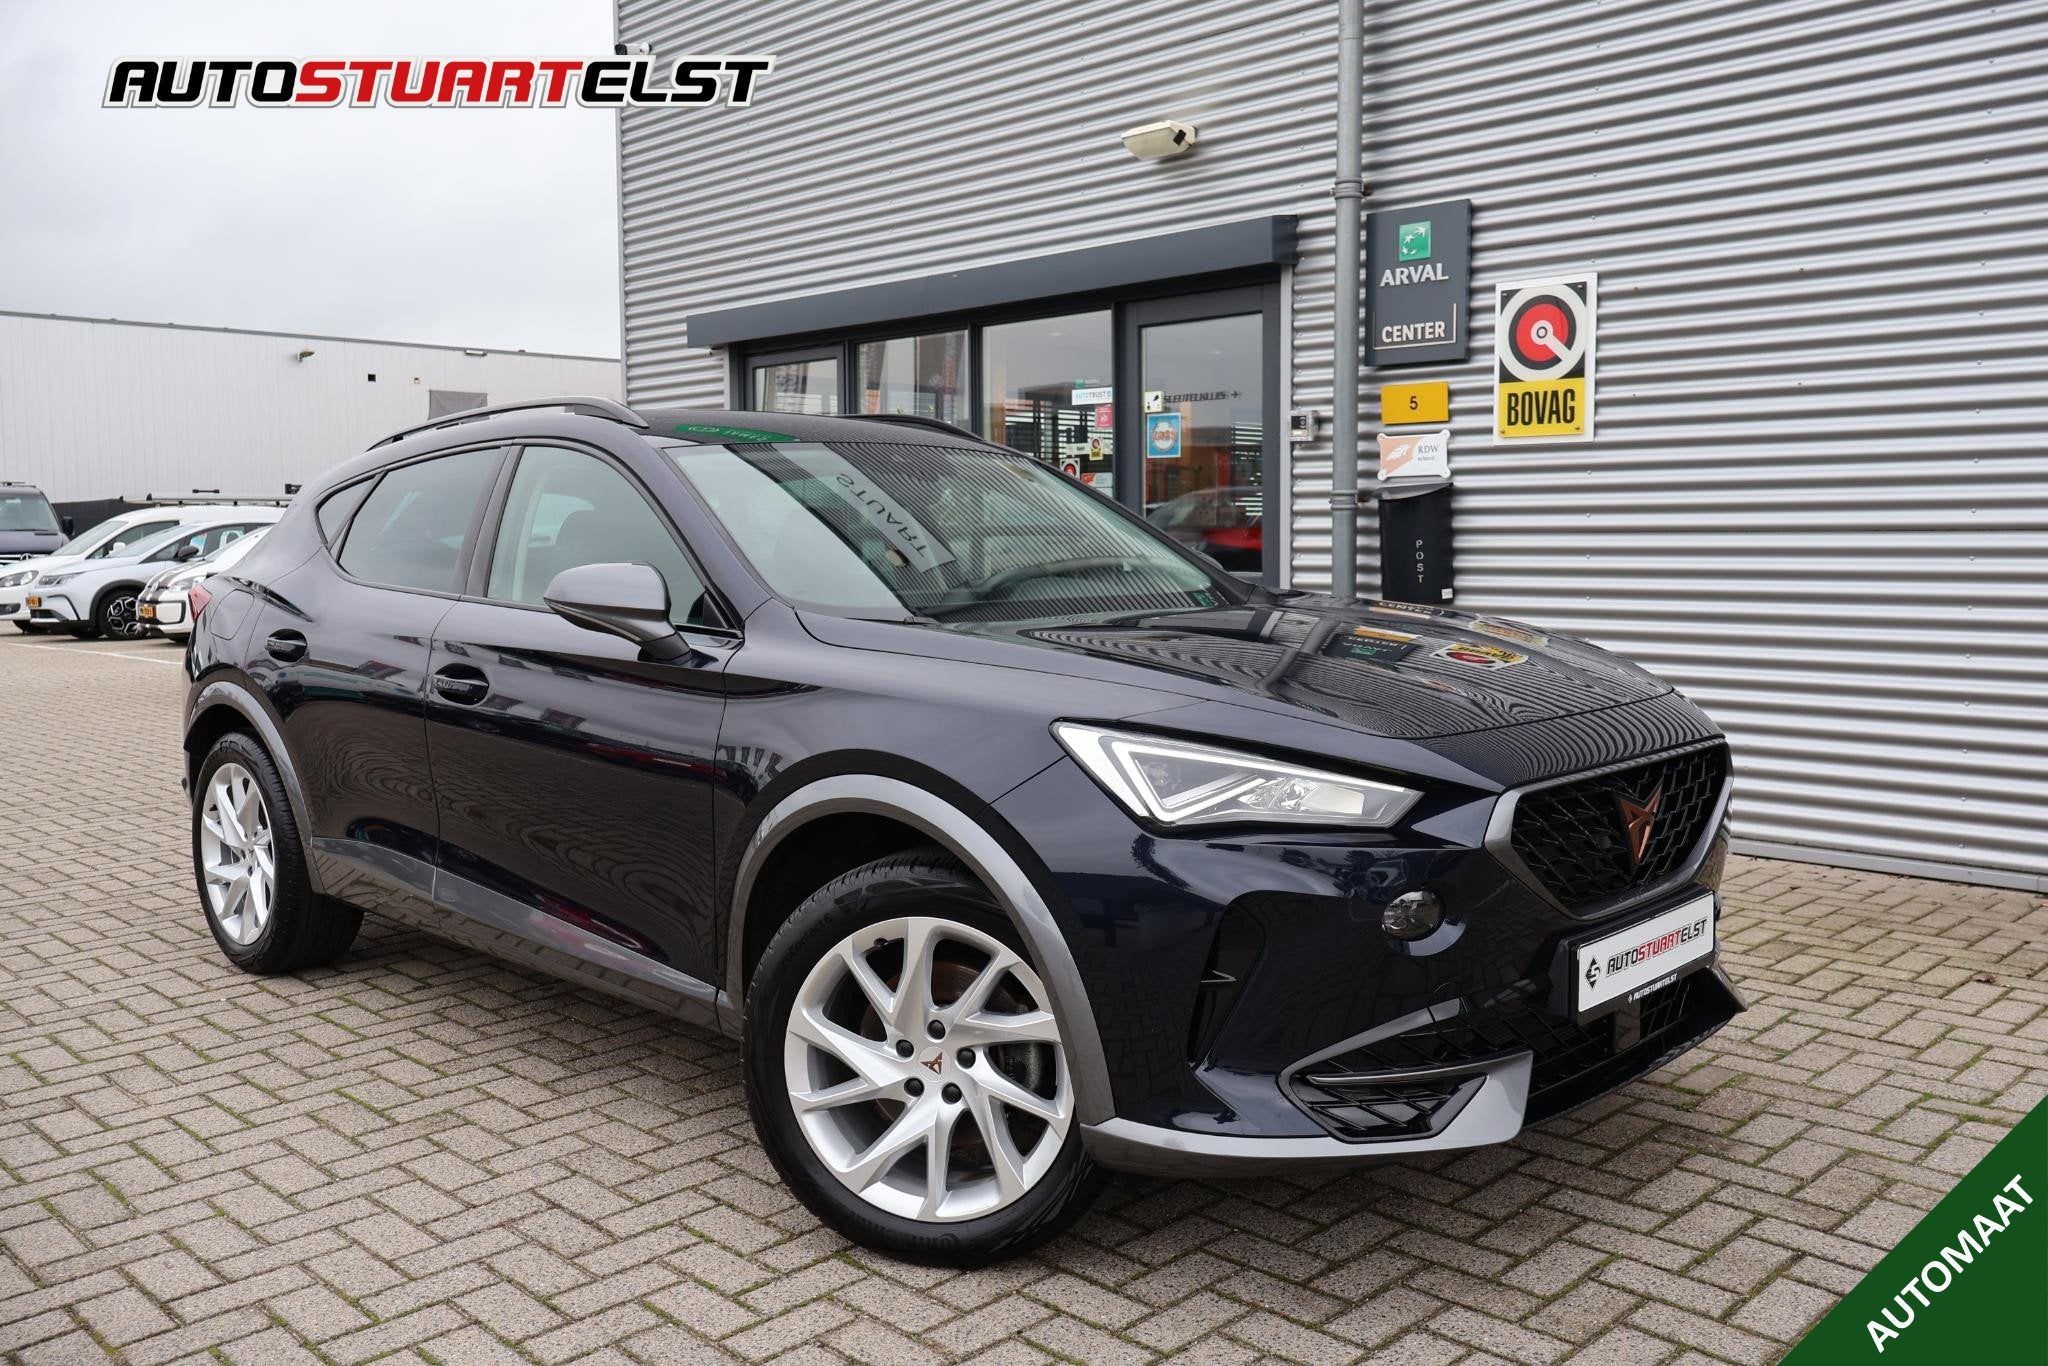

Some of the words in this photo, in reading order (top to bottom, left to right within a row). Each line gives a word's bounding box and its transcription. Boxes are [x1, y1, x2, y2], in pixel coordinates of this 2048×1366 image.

[1380, 262, 1449, 287] ARVAL
[1381, 320, 1446, 343] CENTER
[1409, 395, 1419, 411] 5
[1506, 388, 1576, 427] BOVAG
[1417, 444, 1439, 454] RDW
[1415, 539, 1425, 584] POST
[1606, 918, 1708, 976] AUTOSTUARTELST
